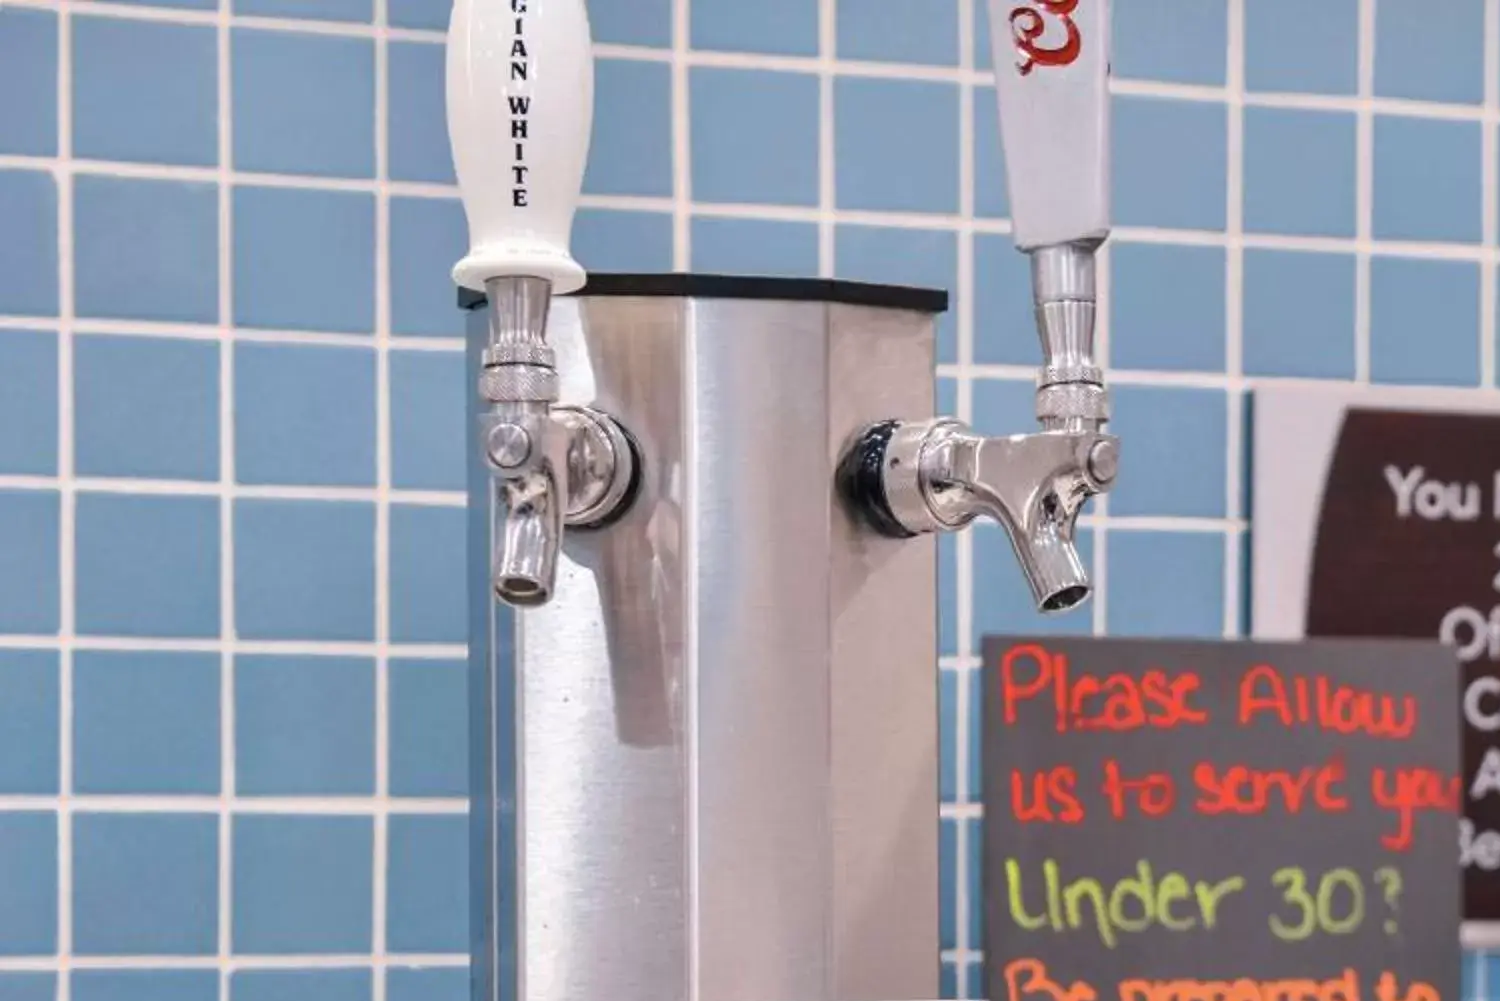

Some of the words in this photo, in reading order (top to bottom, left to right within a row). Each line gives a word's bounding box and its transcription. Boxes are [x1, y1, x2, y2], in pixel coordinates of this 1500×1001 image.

[507, 97, 530, 207] WHITE
[1384, 465, 1480, 520] You
[1001, 643, 1207, 733] Please
[1238, 664, 1417, 738] Allow
[1010, 765, 1085, 823] us
[1103, 758, 1175, 818] to
[1192, 756, 1349, 815] serve
[1005, 859, 1246, 948] Under
[1268, 866, 1403, 941] 30?
